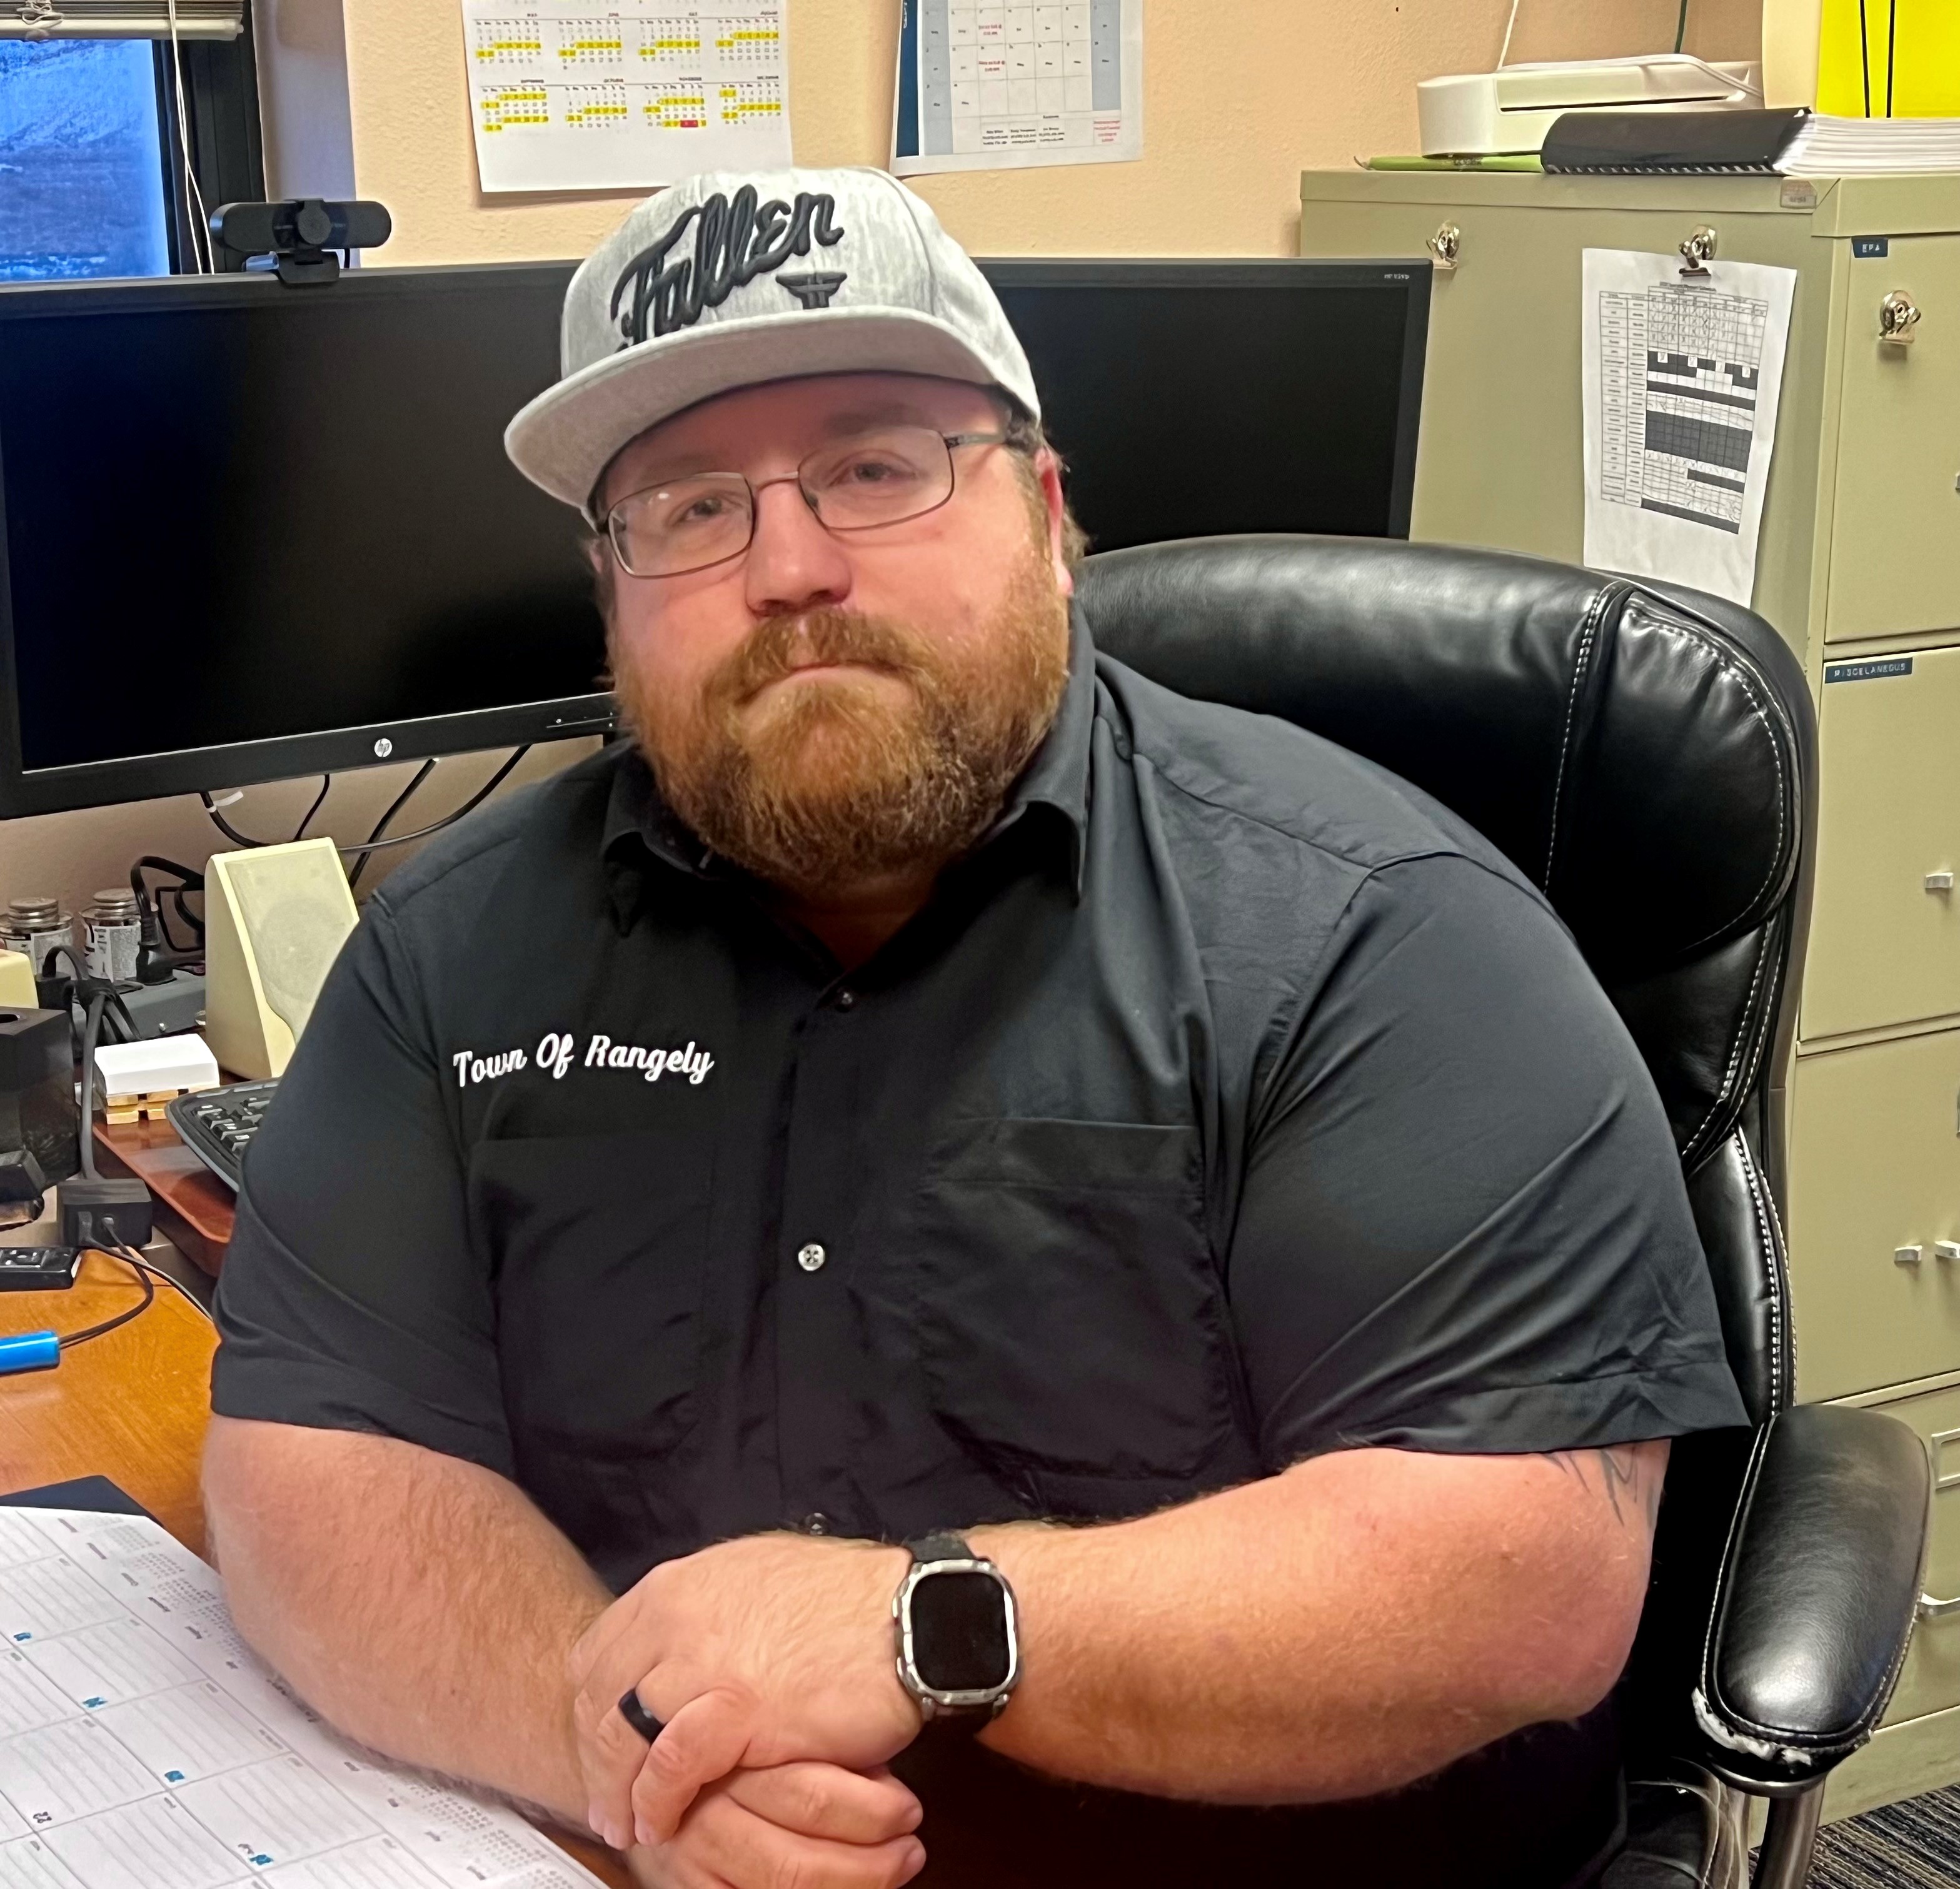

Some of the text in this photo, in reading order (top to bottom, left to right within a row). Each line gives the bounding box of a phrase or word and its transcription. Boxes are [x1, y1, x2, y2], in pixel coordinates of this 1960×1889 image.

[610, 183, 845, 353] Fallen
[1862, 243, 1881, 253] EPA
[453, 1033, 715, 1087] Town Of Rangely
